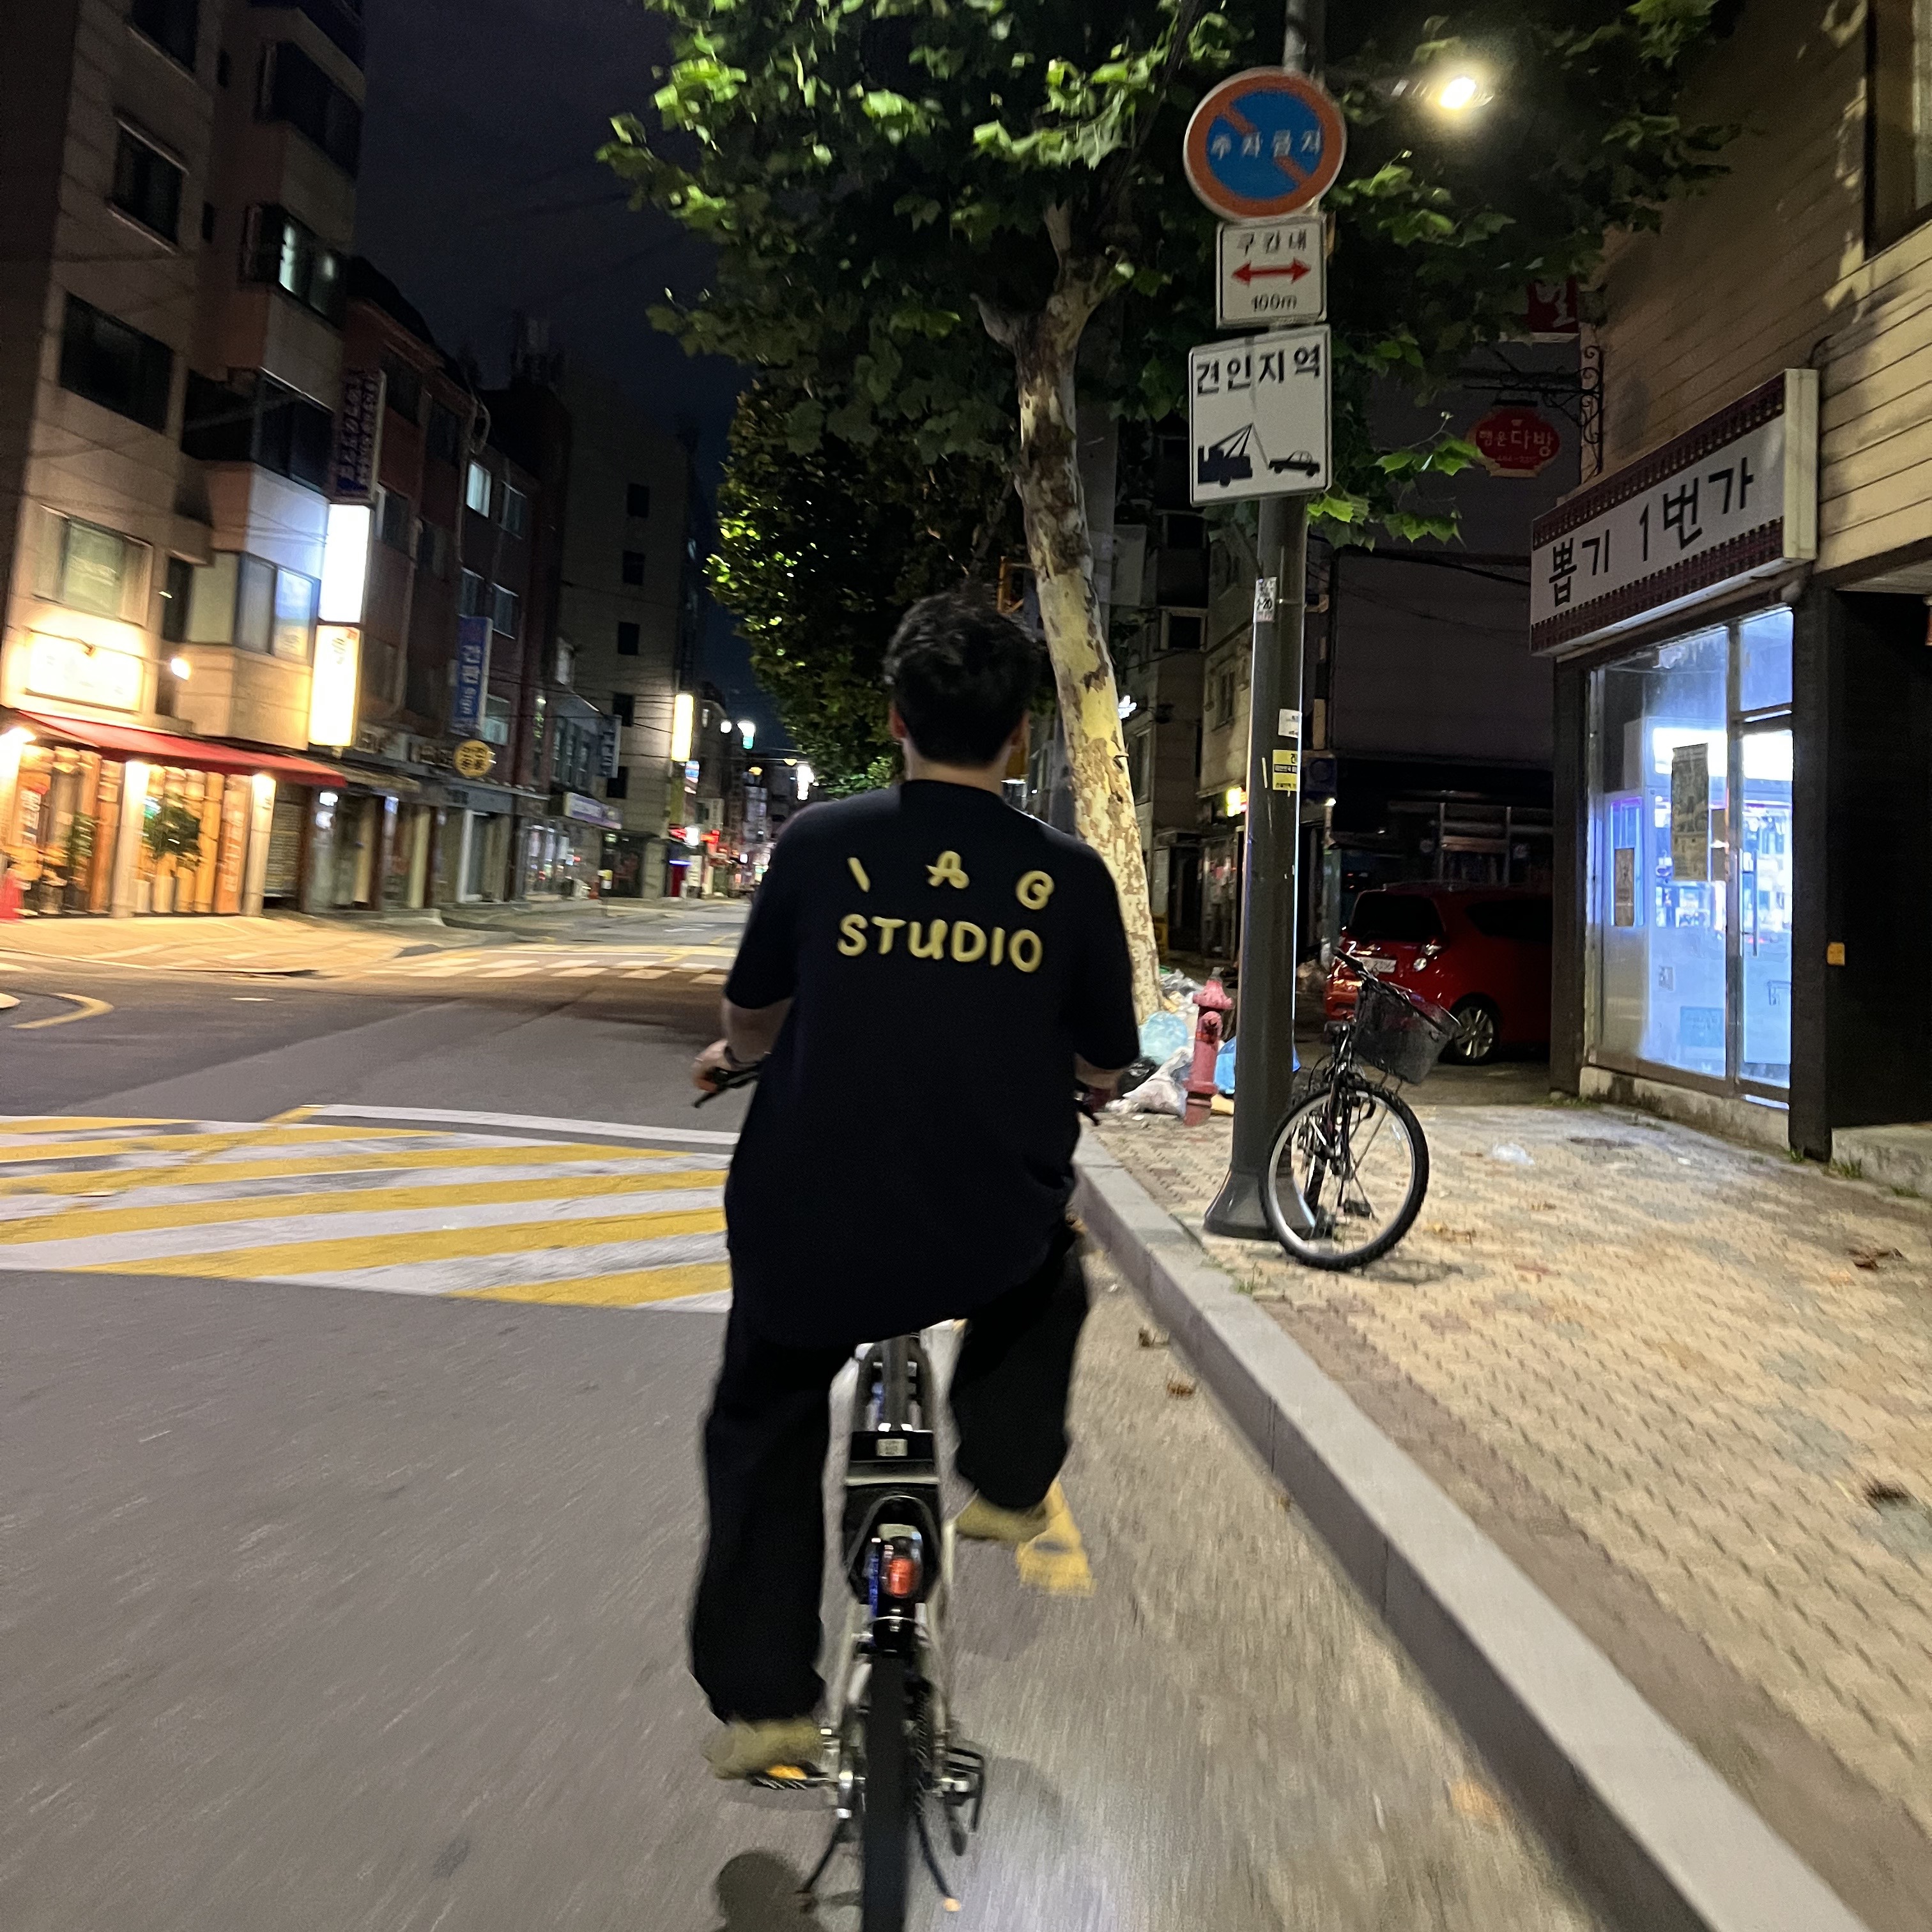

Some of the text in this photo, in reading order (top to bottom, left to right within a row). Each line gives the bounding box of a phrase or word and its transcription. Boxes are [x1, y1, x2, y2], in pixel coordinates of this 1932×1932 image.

[1238, 229, 1307, 256] 구간내
[1251, 293, 1298, 312] 100m
[1197, 345, 1321, 395] 견인지역
[1549, 529, 1610, 608] 뽑기
[836, 914, 1043, 974] STUDIO
